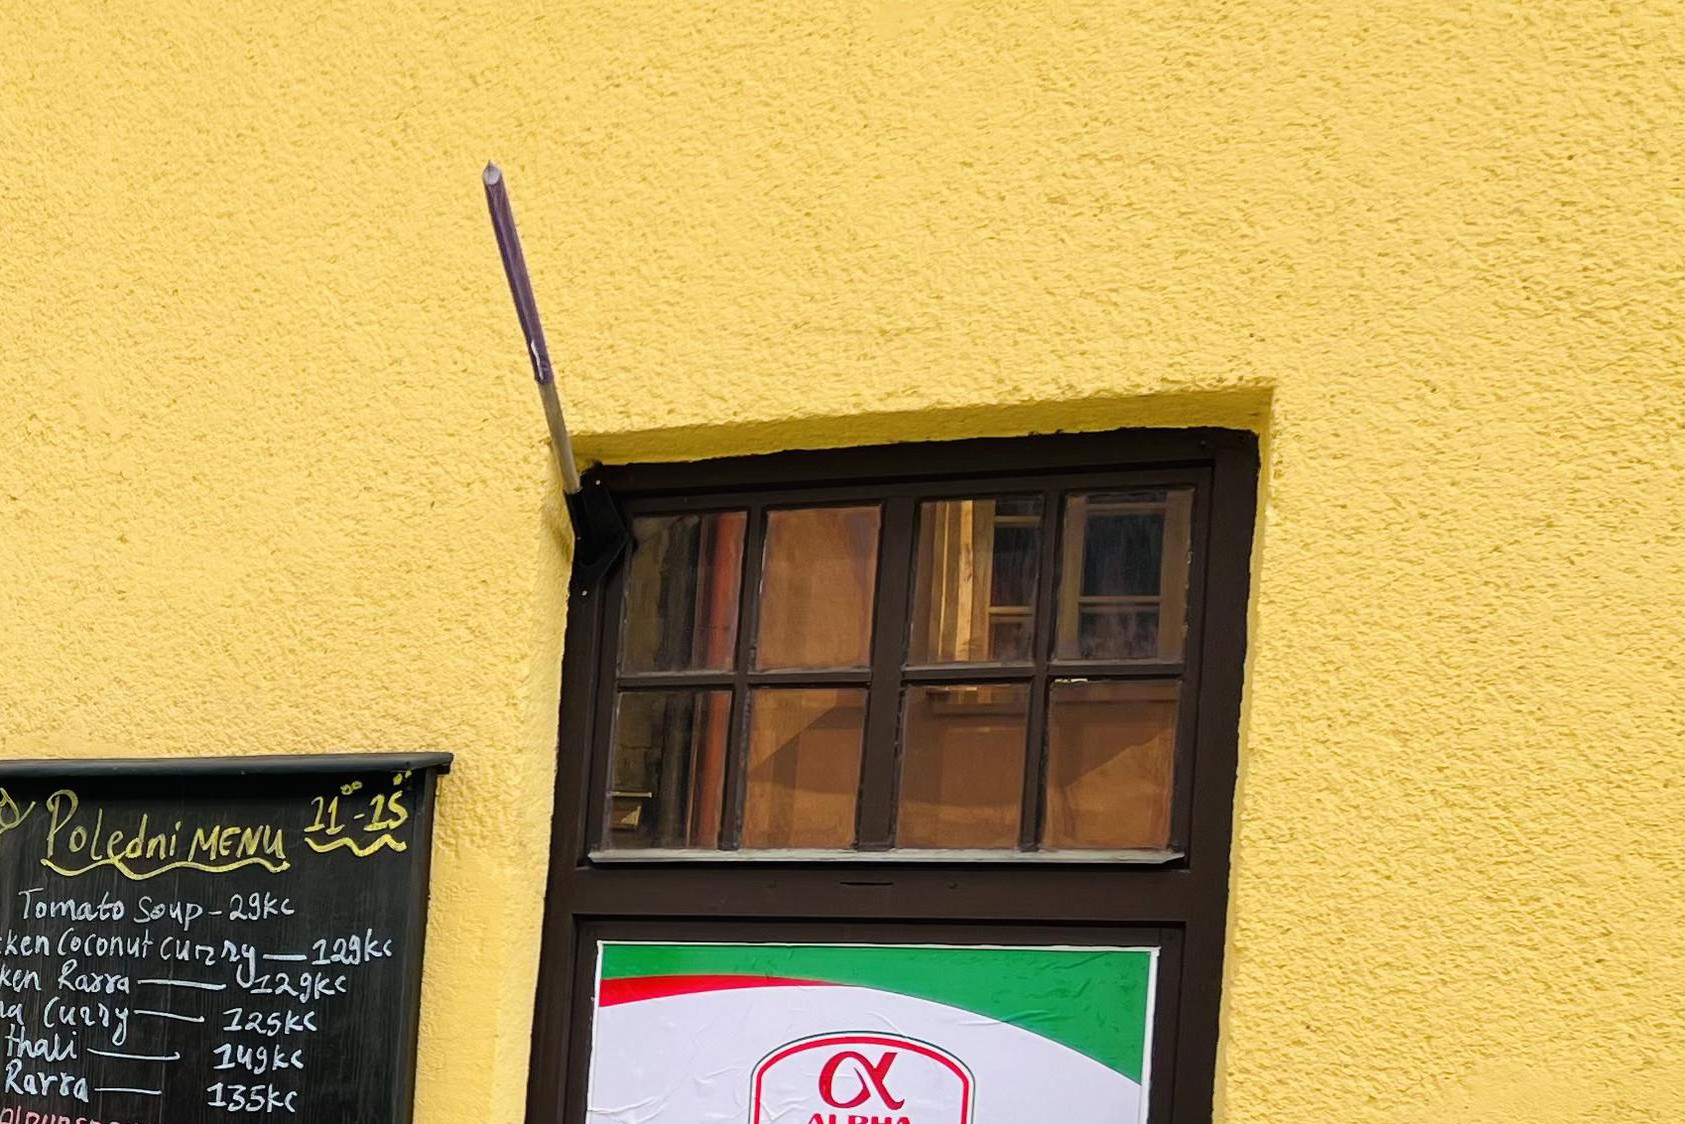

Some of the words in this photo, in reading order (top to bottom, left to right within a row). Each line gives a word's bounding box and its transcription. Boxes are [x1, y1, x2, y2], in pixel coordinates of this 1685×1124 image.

[188, 825, 286, 861] MENU
[18, 887, 125, 921] Tomato
[133, 895, 203, 931] Soup
[57, 927, 154, 958] Coconut
